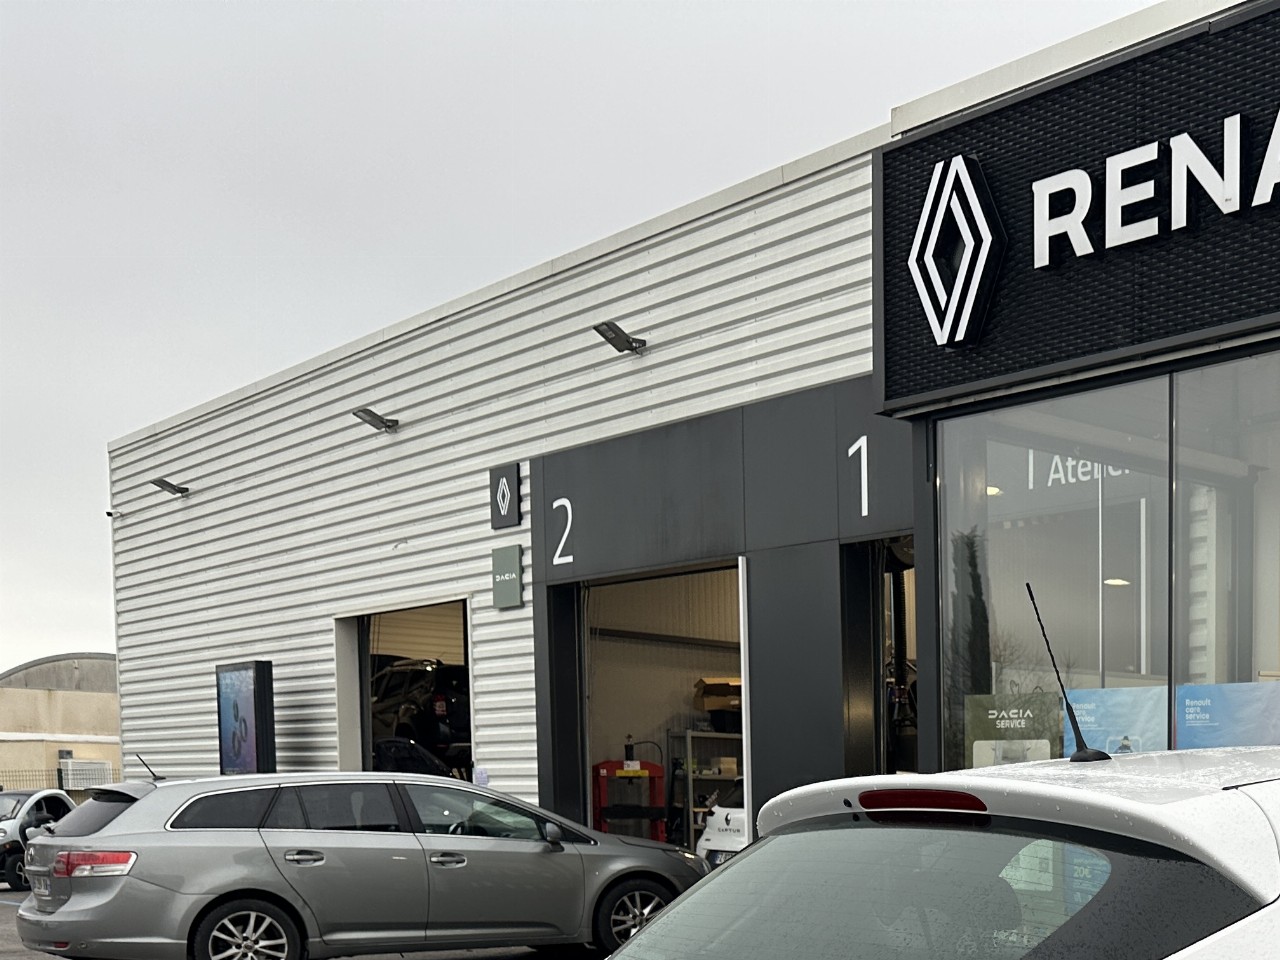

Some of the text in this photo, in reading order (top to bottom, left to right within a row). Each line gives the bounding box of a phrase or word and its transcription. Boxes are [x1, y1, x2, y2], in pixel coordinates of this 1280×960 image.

[847, 435, 869, 517] 1
[552, 497, 574, 565] 2
[495, 573, 517, 582] DACIA
[1185, 699, 1211, 707] Renault
[988, 709, 1033, 719] DACIA
[996, 719, 1026, 729] SERVICE
